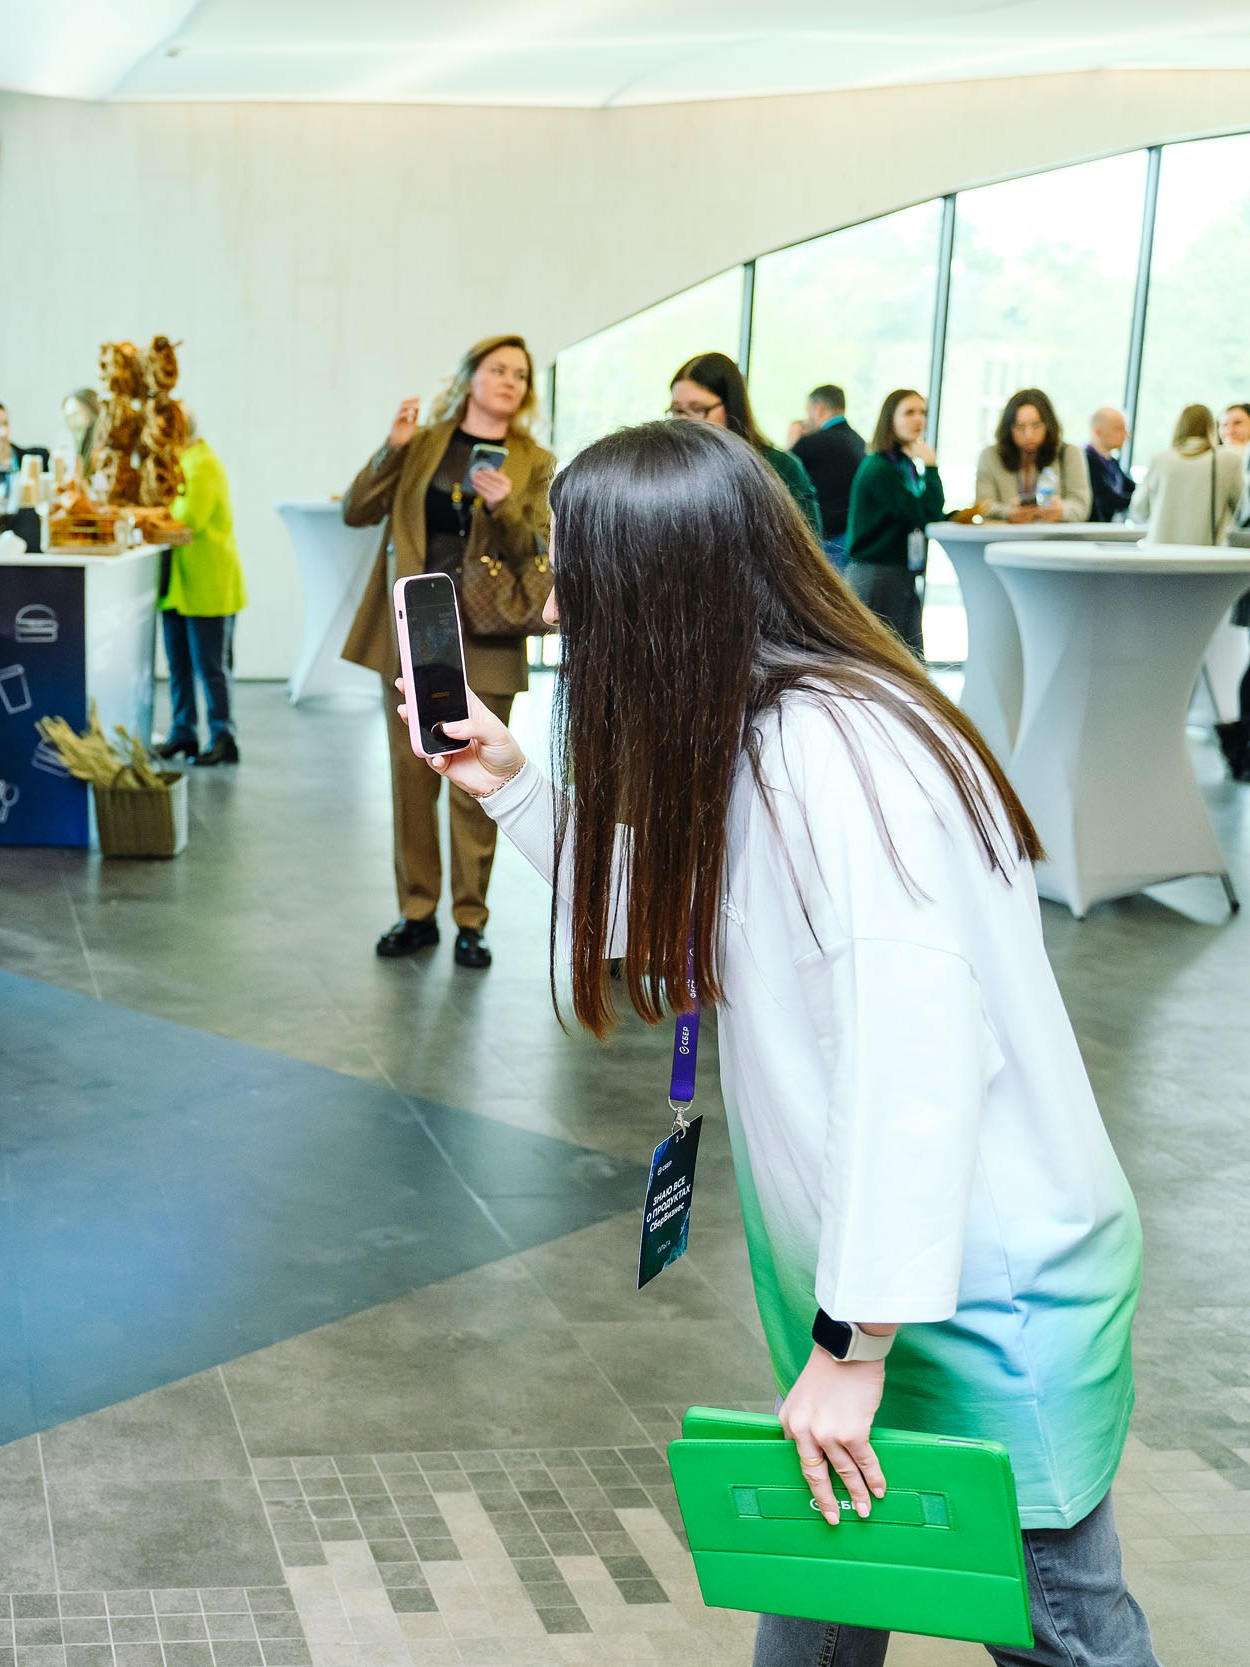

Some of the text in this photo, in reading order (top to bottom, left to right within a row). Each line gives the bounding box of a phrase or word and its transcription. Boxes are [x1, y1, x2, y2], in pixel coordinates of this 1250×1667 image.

[662, 1160, 673, 1171] СБЕР
[646, 1184, 691, 1223] О ПРОДУКТАХ
[652, 1175, 686, 1206] ЗНАЮ ВСЕ
[649, 1202, 685, 1232] СберБизнес
[657, 1239, 671, 1254] ОЛЬГА
